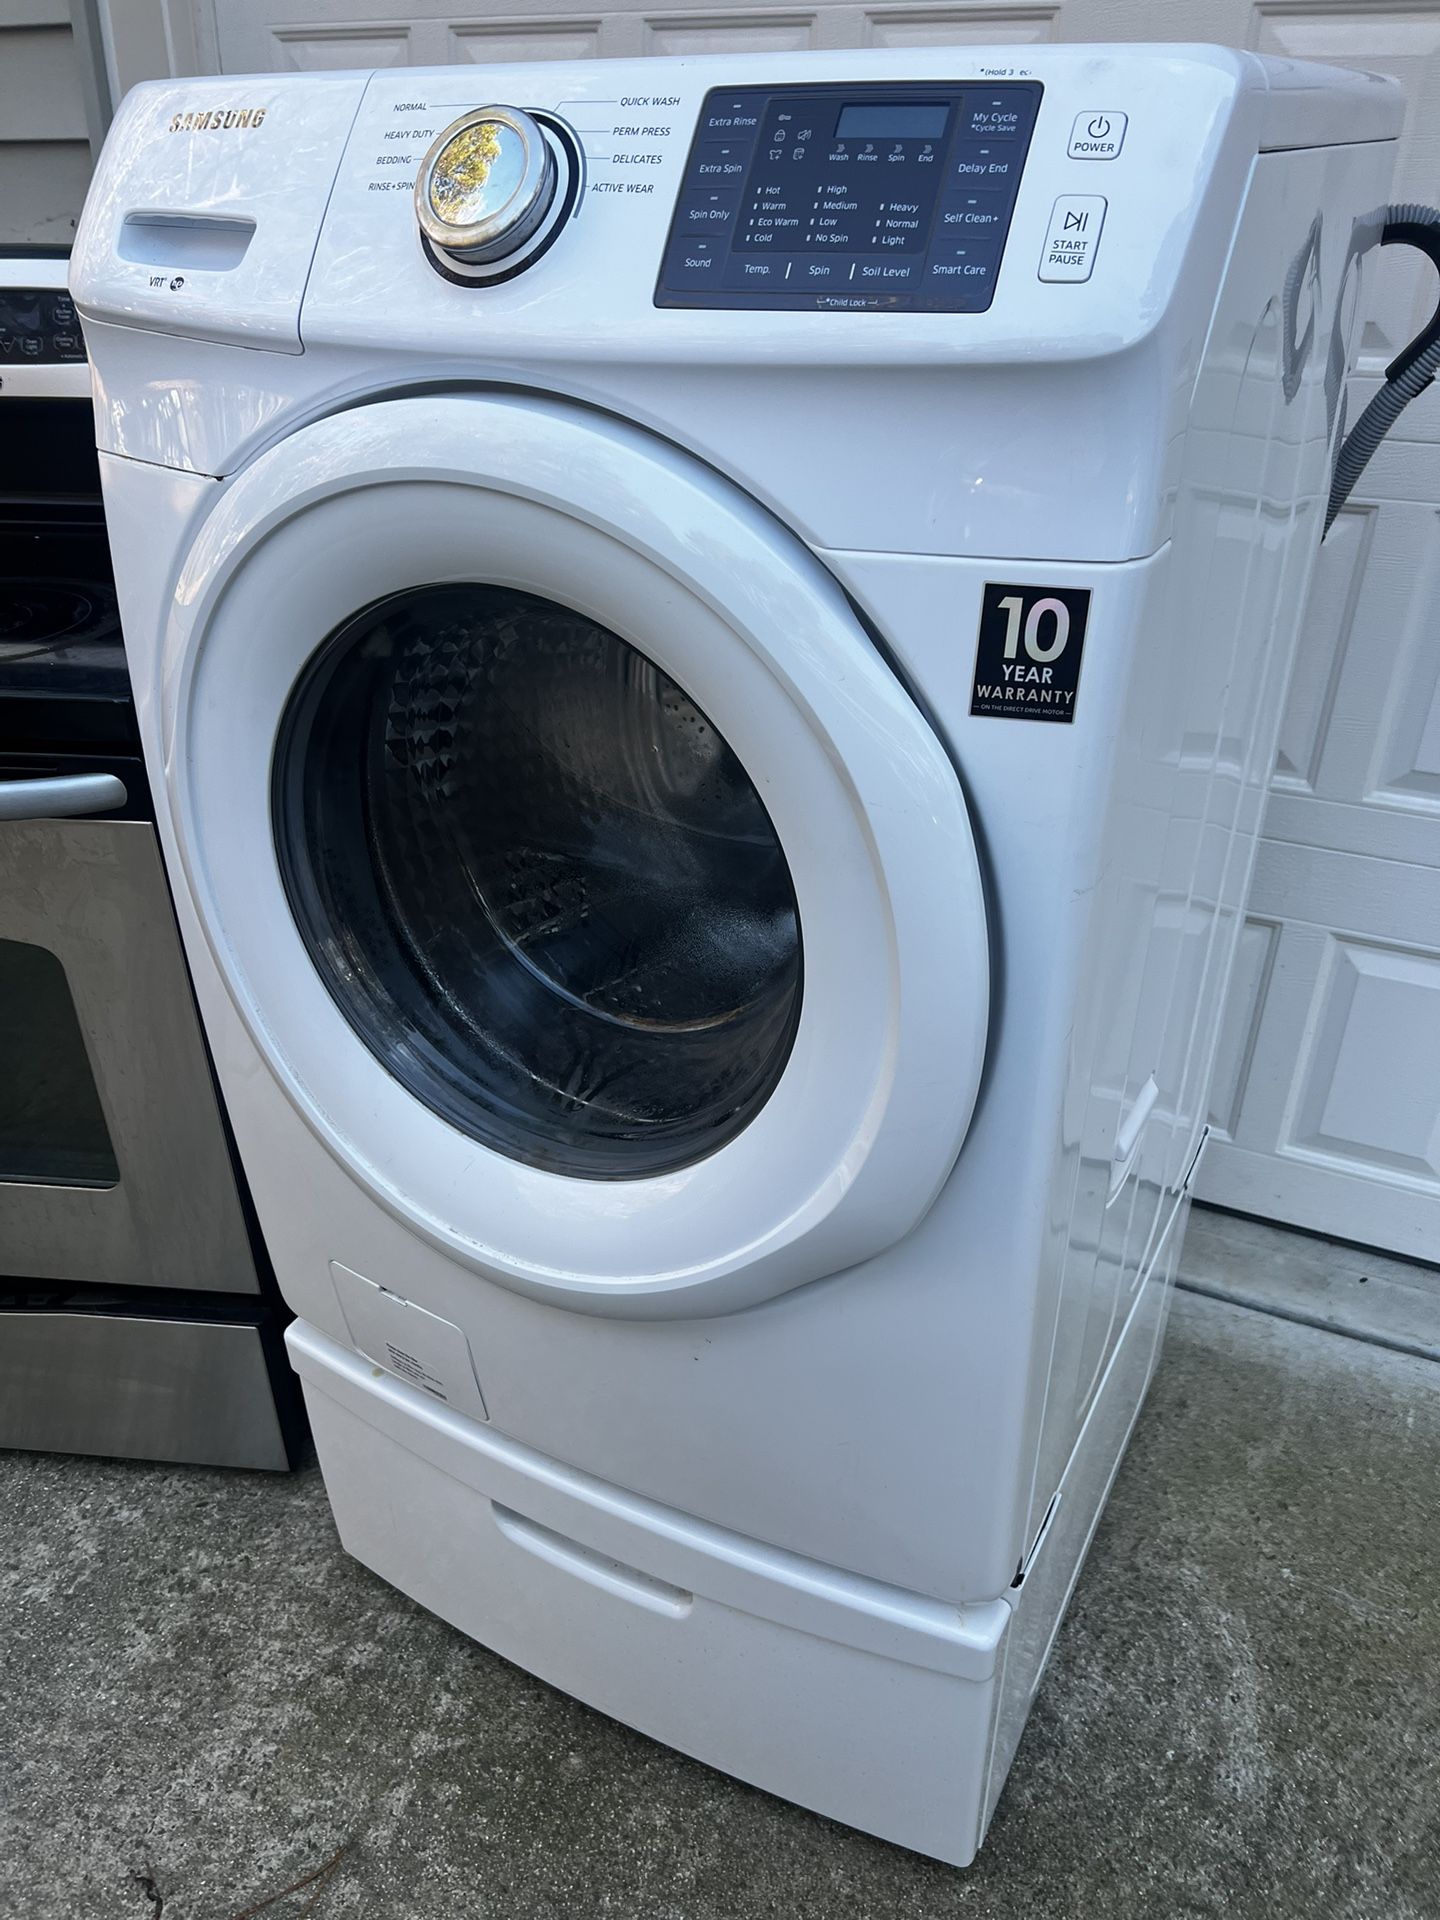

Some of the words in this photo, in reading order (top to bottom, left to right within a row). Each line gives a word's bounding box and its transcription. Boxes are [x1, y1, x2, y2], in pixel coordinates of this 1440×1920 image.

[620, 97, 649, 106] QUICK
[652, 97, 680, 106] WASH
[394, 103, 427, 112] NORMAL
[169, 108, 267, 132] SAMSUNG
[709, 118, 732, 126] Extra
[734, 117, 757, 126] Rinse
[973, 114, 988, 122] My
[991, 113, 1018, 122] Cycle
[384, 130, 410, 140] HEAVY
[412, 129, 434, 138] DUTY
[612, 127, 639, 136] PERM
[640, 127, 670, 136] PRESS
[1074, 142, 1114, 152] POWER
[376, 155, 411, 164] BEDDING
[612, 155, 662, 164] DELICATES
[700, 165, 721, 173] Extra
[723, 165, 742, 174] Spin
[958, 164, 986, 174] Delay
[989, 164, 1008, 173] End
[592, 183, 623, 192] ACTIVE
[627, 184, 654, 193] WEAR
[766, 186, 780, 194] Hot
[827, 186, 847, 195] High
[823, 202, 857, 210] Medium
[890, 203, 919, 213] Heavy
[689, 210, 707, 219] Spin
[710, 210, 730, 220] Only
[944, 214, 962, 222] Self
[886, 220, 918, 228] Normal
[829, 234, 848, 243] Spin
[882, 236, 904, 245] Light
[1053, 240, 1088, 250] START
[684, 258, 711, 267] Sound
[1049, 254, 1084, 265] PAUSE
[745, 265, 770, 275] Temp.
[809, 266, 830, 275] Spin
[862, 267, 880, 276] Soil
[883, 268, 910, 277] Level
[932, 265, 961, 274] Smart
[964, 265, 986, 274] Care
[998, 596, 1070, 662] 10
[1002, 664, 1053, 684] YEAR
[977, 685, 1074, 704] WARRANTY
